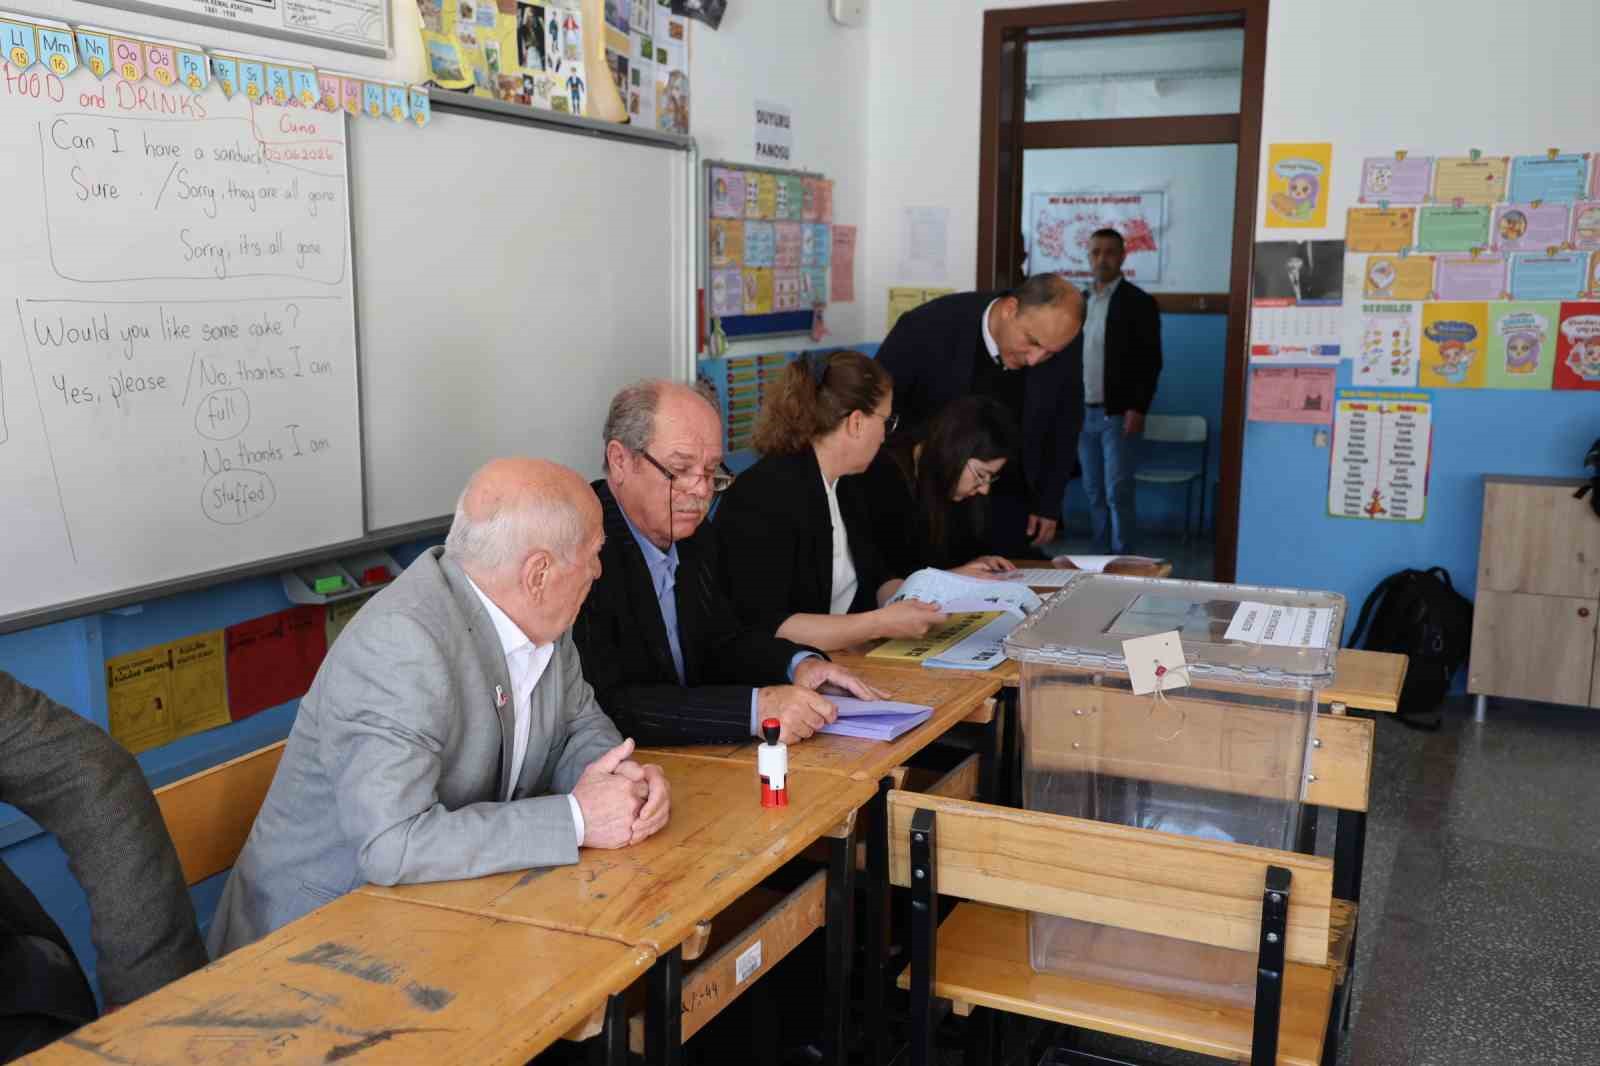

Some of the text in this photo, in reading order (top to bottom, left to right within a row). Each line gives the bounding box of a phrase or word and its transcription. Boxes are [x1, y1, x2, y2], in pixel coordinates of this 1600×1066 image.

[43, 36, 70, 53] Mm
[86, 39, 104, 55] Nn
[80, 86, 105, 108] and
[116, 80, 207, 118] DRINKS
[52, 119, 95, 150] Can
[108, 128, 124, 153] I
[143, 130, 182, 158] have
[194, 148, 204, 160] a
[70, 166, 120, 202] Sure
[228, 178, 256, 212] they
[258, 187, 278, 199] are
[285, 177, 298, 200] all
[269, 231, 283, 254] all
[296, 242, 320, 269] gone
[33, 312, 110, 346] Would
[120, 324, 151, 360] you
[160, 306, 191, 342] like
[201, 323, 239, 342] some
[111, 369, 168, 408] please
[238, 356, 285, 382] thanks
[288, 345, 304, 377] I
[310, 361, 333, 376] am
[208, 396, 237, 429] full
[201, 424, 331, 476] No thanks I am
[213, 480, 265, 517] stuffed
